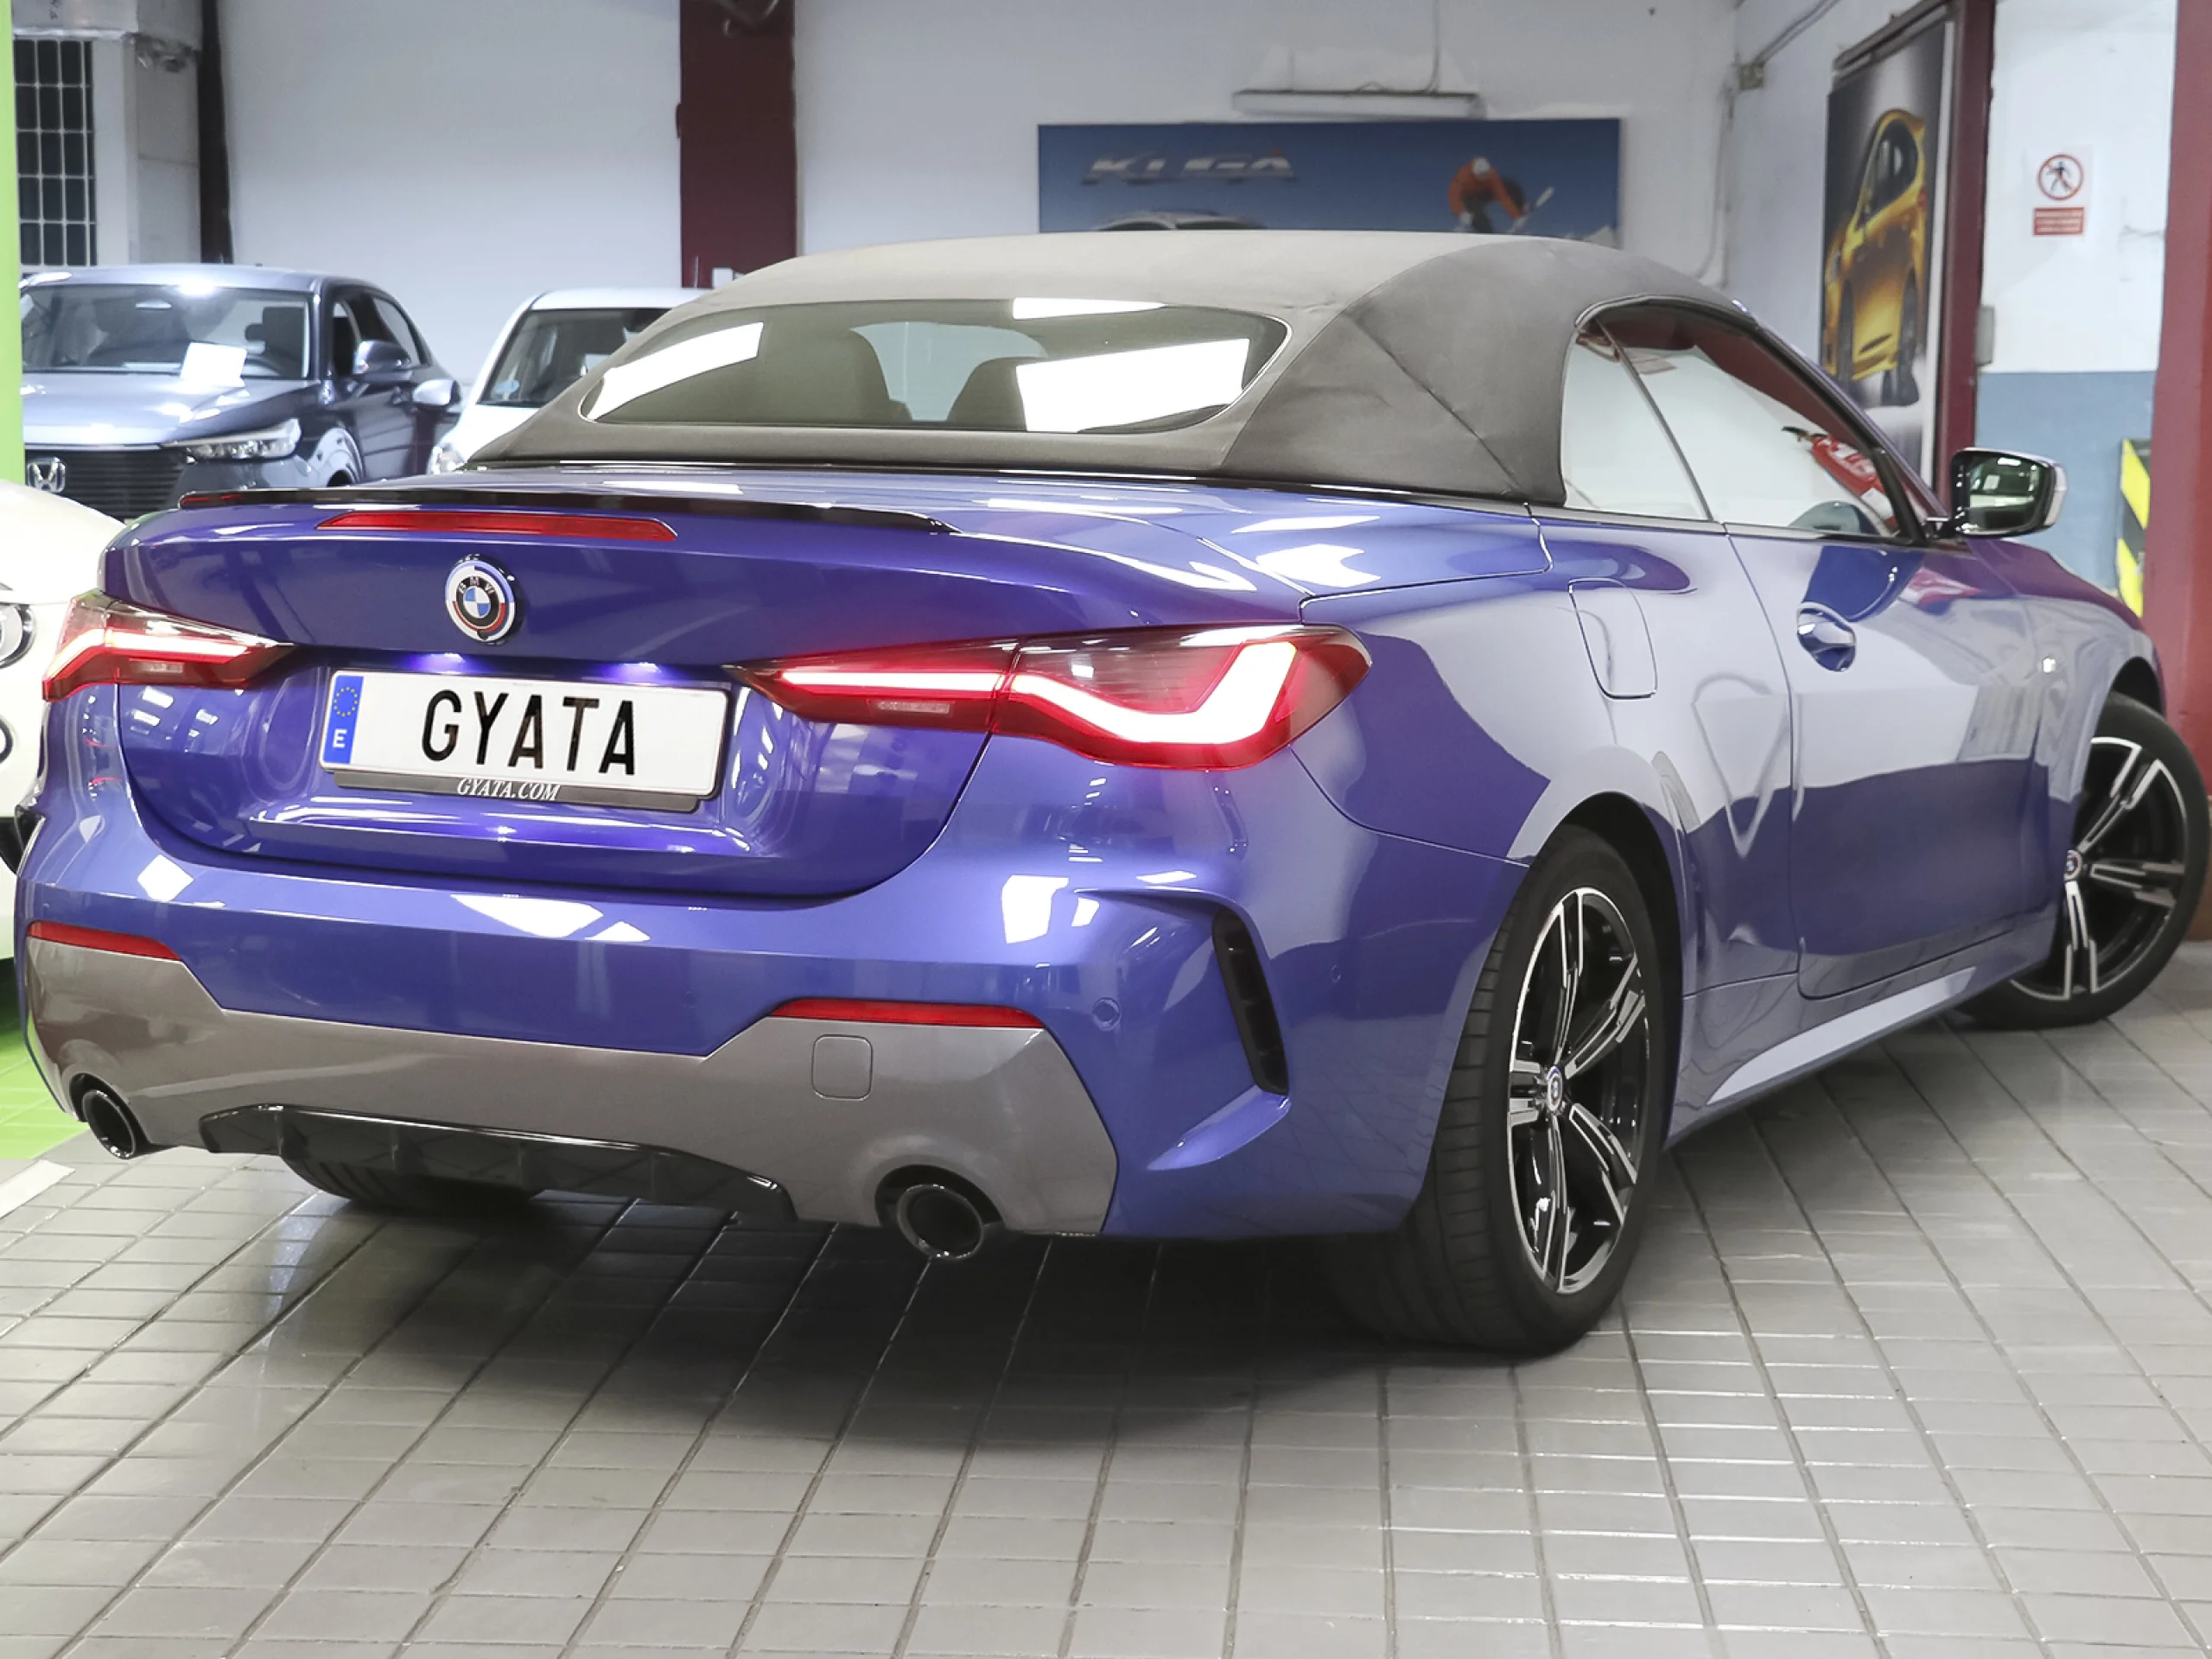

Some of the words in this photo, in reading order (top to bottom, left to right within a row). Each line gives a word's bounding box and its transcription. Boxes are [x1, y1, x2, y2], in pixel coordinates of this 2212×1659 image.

[332, 729, 347, 748] E
[422, 689, 636, 776] GYATA
[456, 778, 561, 801] GYATA.COM
